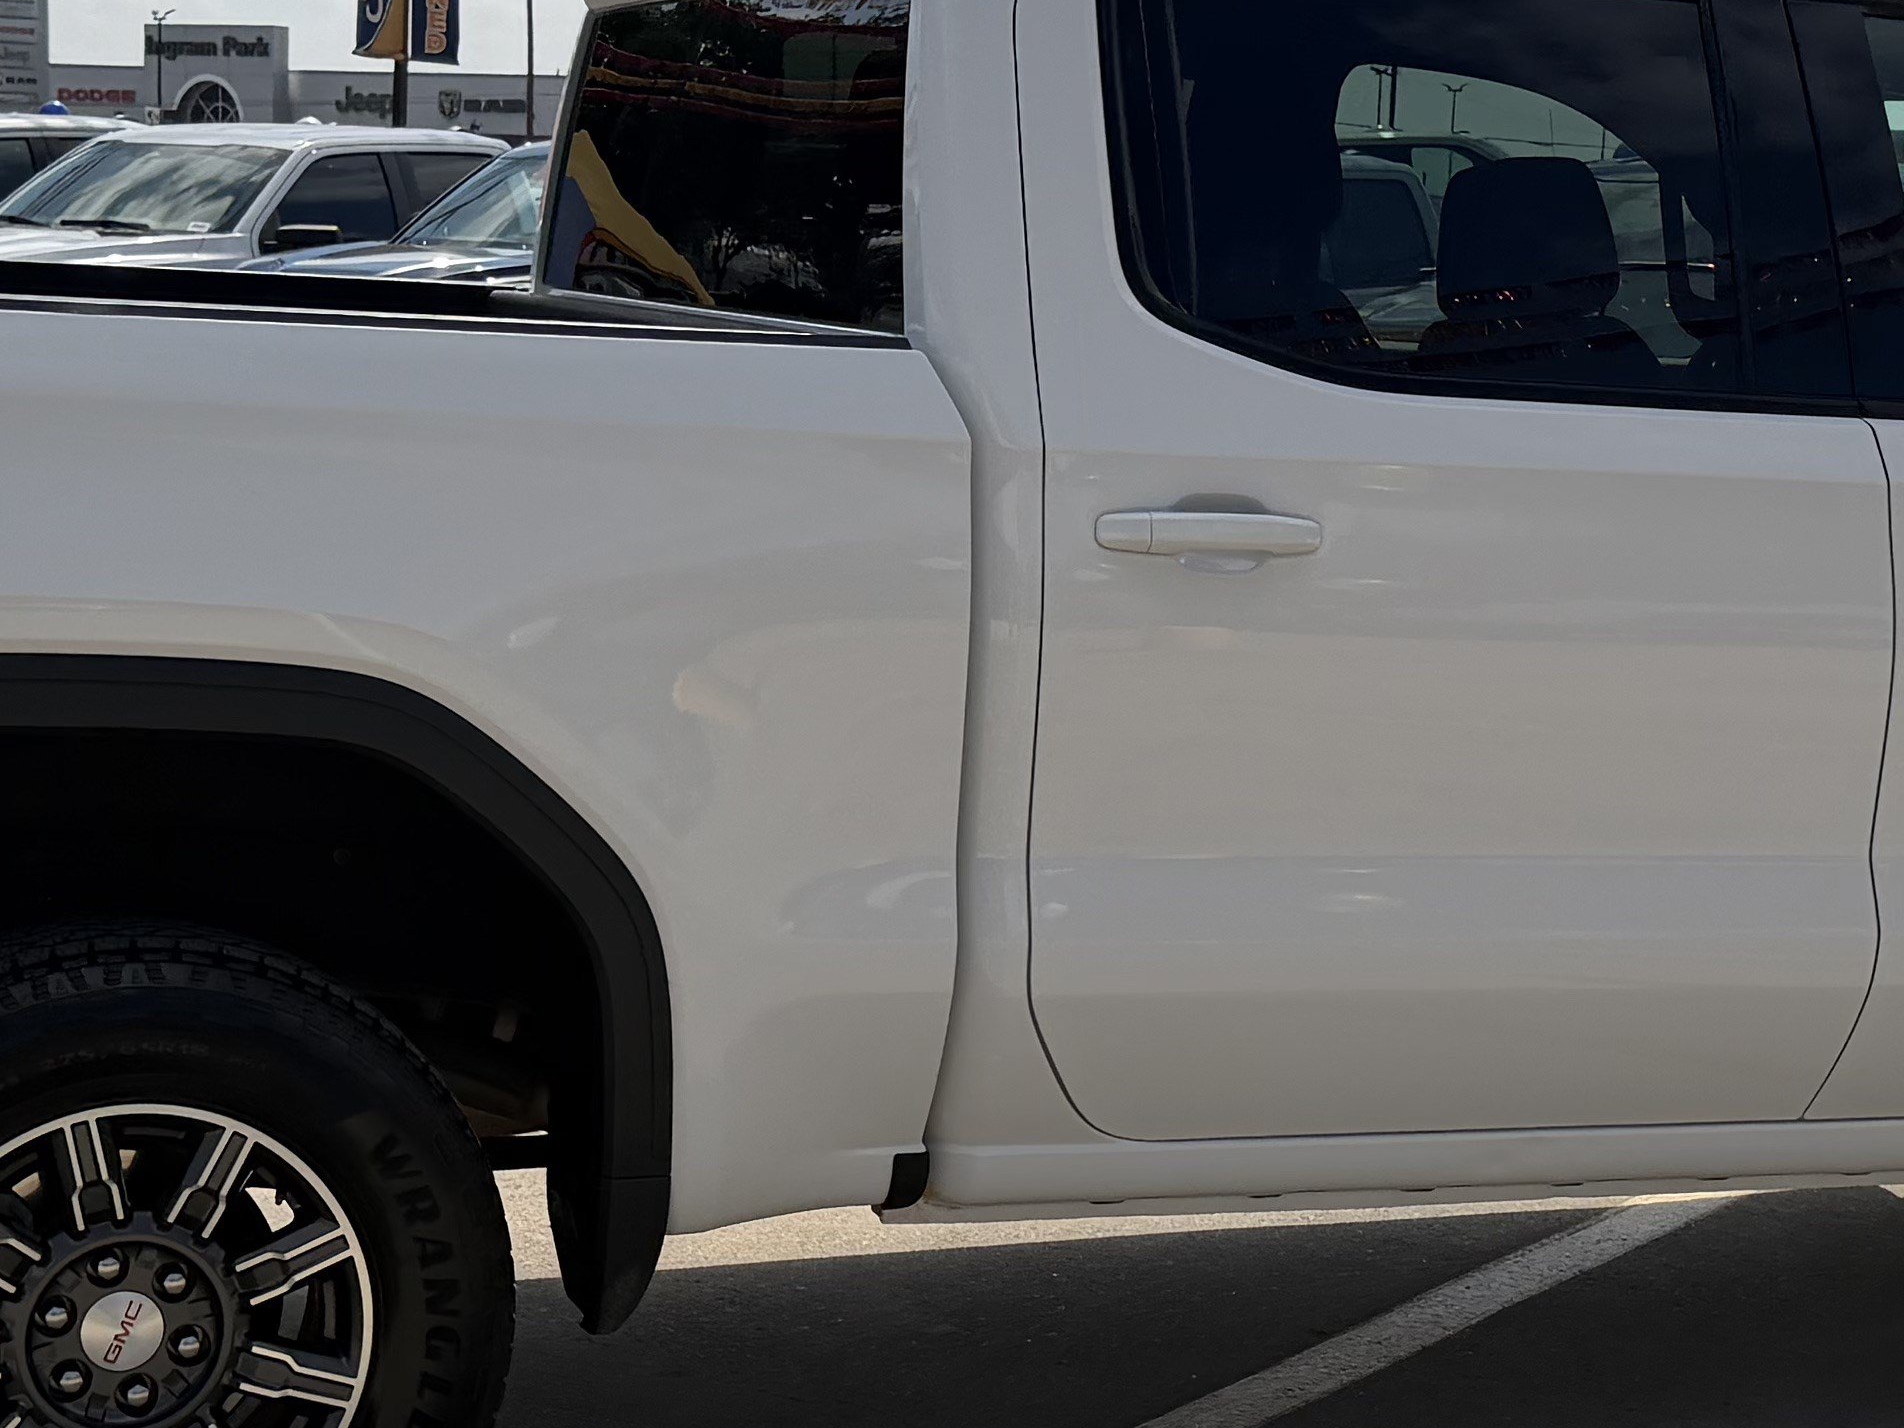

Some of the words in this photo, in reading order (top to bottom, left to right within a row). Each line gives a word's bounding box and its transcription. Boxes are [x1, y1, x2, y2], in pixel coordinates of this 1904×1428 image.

[222, 36, 269, 57] Park
[57, 88, 137, 104] DODGE
[103, 1300, 143, 1364] GMC
